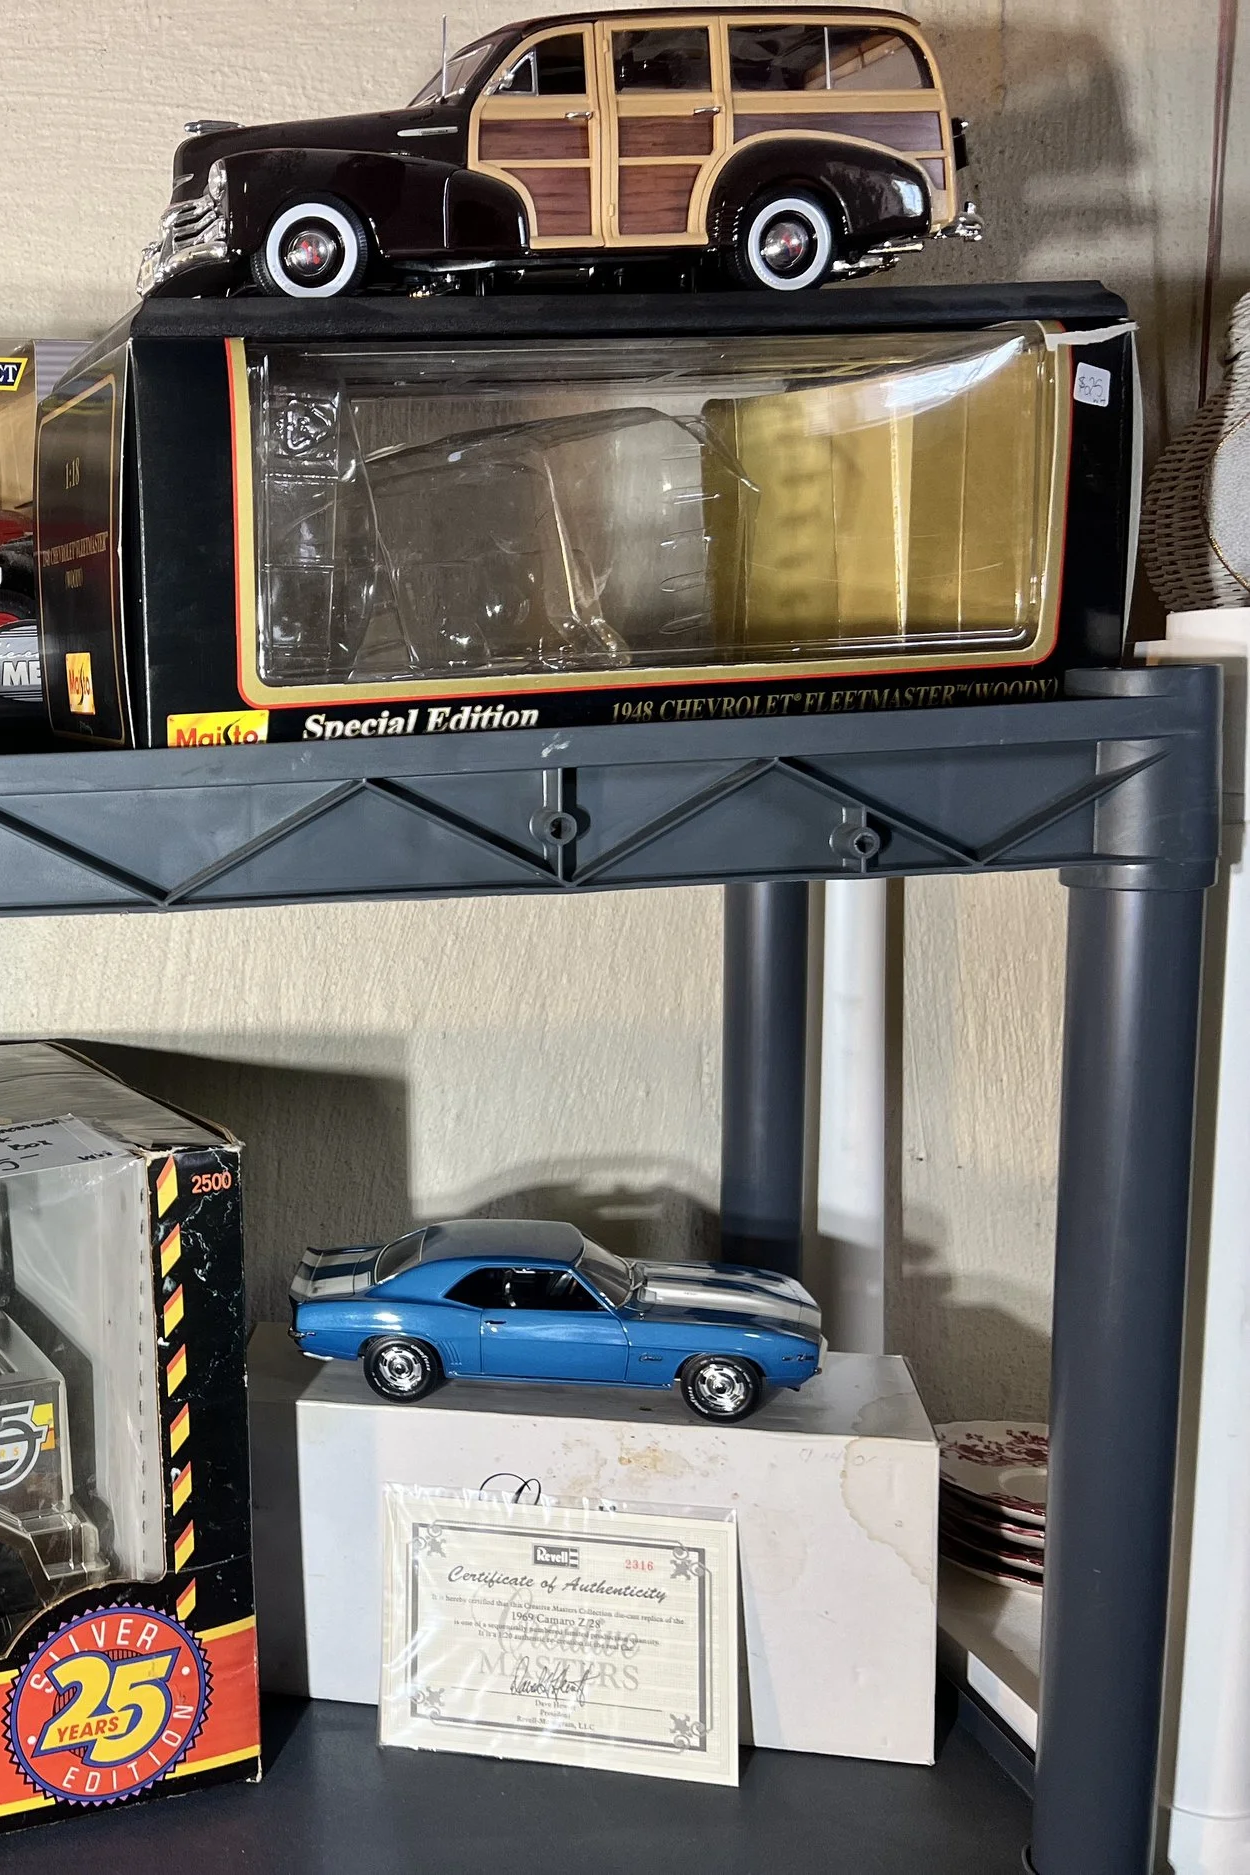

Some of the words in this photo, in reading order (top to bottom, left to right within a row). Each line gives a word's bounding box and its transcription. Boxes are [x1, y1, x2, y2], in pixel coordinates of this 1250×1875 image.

[65, 456, 81, 489] 1:18
[2, 660, 42, 687] ME
[303, 709, 415, 741] Special
[426, 704, 540, 734] Edition
[611, 701, 654, 723] 1948
[176, 714, 260, 748] Maisto
[190, 1169, 233, 1195] 2500
[536, 1546, 569, 1566] Revell
[625, 1559, 654, 1571] 2316
[448, 1566, 534, 1589] Certificate
[540, 1576, 558, 1594] of
[563, 1577, 668, 1604] Authenticity
[511, 1611, 534, 1621] 1969
[536, 1613, 575, 1626] Camaro
[30, 1619, 159, 1694] SILVER
[477, 1648, 640, 1692] MASTERS
[33, 1646, 181, 1767] 25
[56, 1716, 121, 1744] YEARS
[62, 1704, 195, 1793] EDITION
